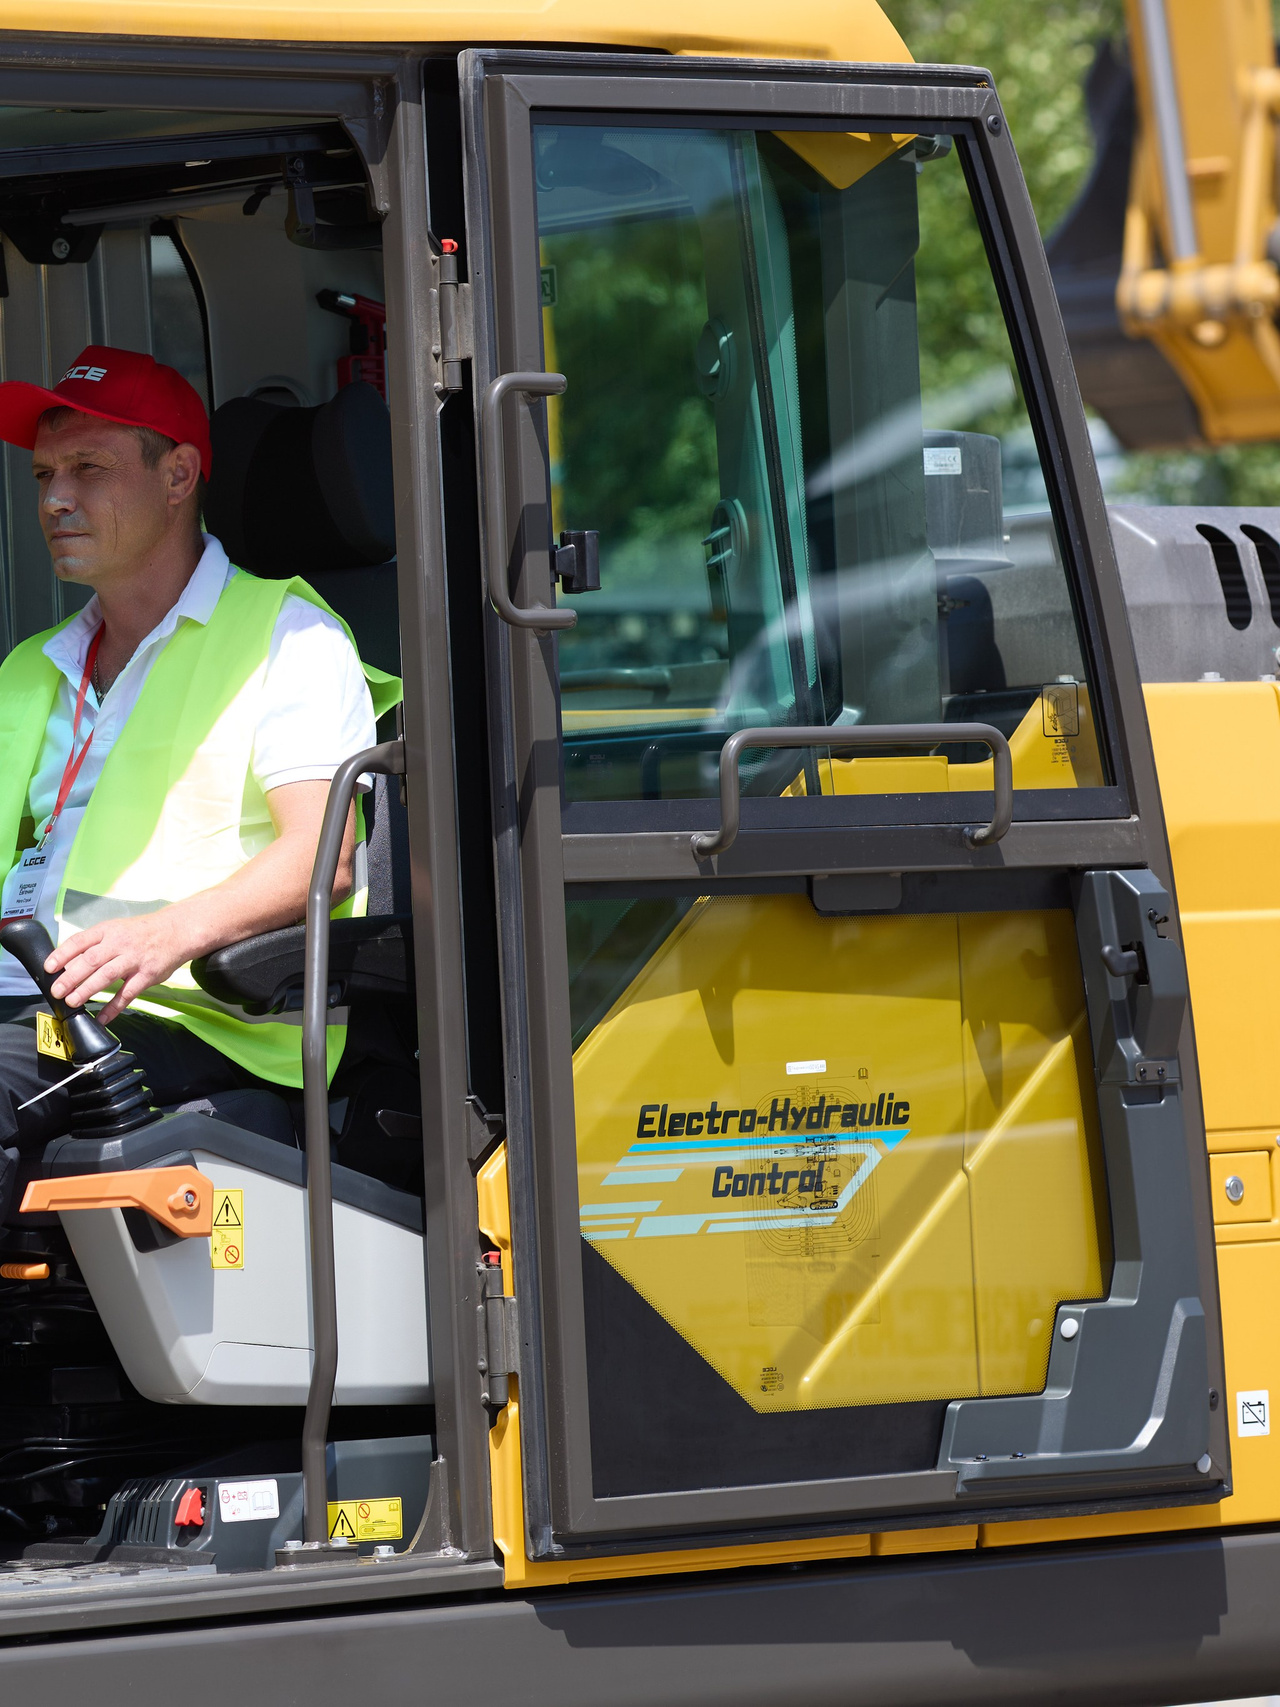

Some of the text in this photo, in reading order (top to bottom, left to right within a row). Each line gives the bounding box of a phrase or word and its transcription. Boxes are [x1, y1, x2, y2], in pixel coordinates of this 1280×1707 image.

[59, 366, 108, 382] GCE
[23, 856, 46, 867] LGCE
[636, 1092, 910, 1138] Electro-Hydraulic
[712, 1161, 825, 1198] Control
